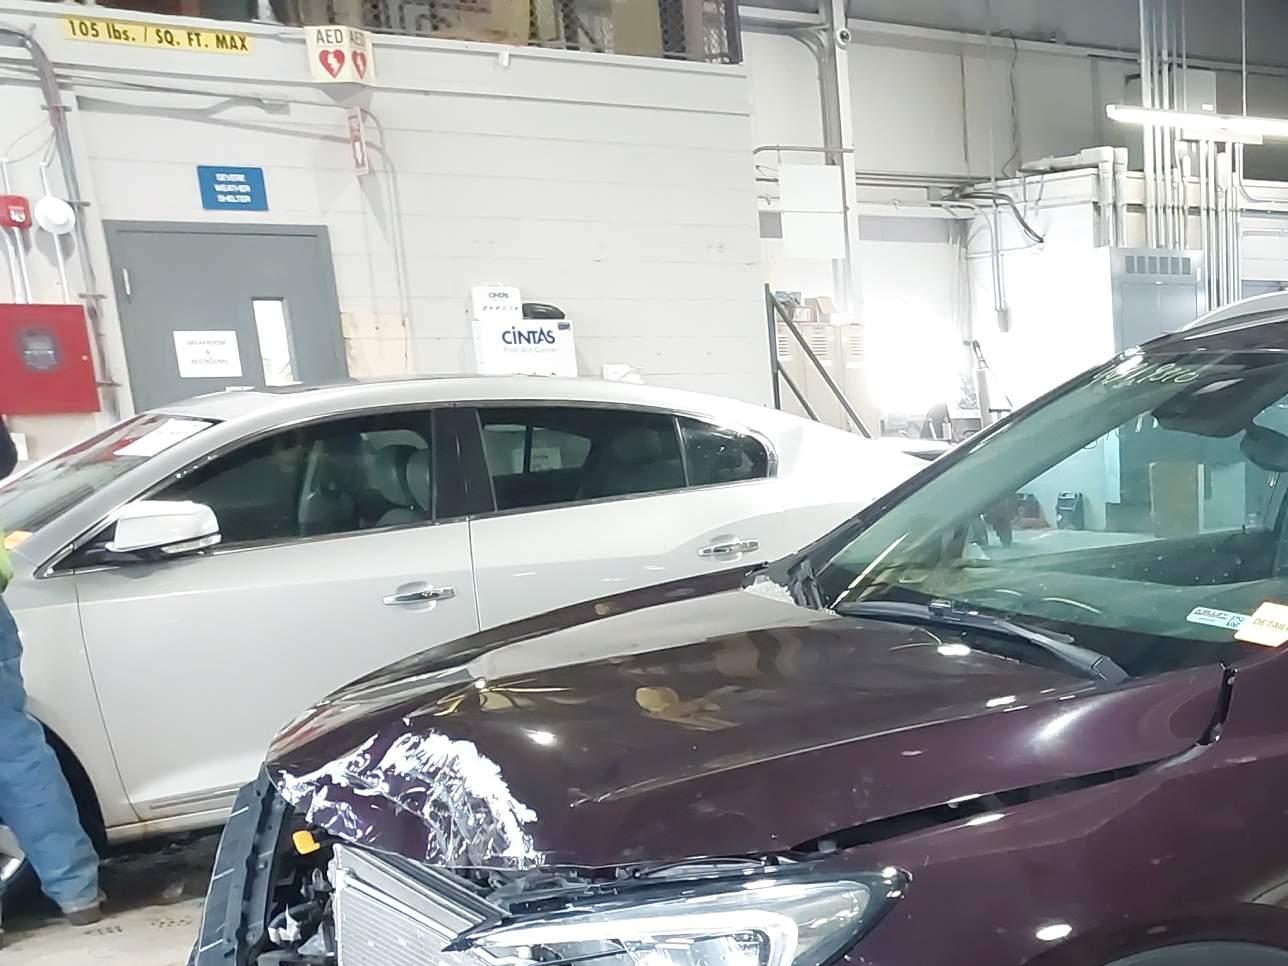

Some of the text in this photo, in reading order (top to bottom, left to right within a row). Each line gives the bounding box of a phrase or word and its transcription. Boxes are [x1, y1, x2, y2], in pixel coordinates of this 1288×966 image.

[69, 20, 249, 51] 105 lbs. / SQ. FT. MAX
[315, 28, 344, 44] AED
[350, 30, 366, 46] AED
